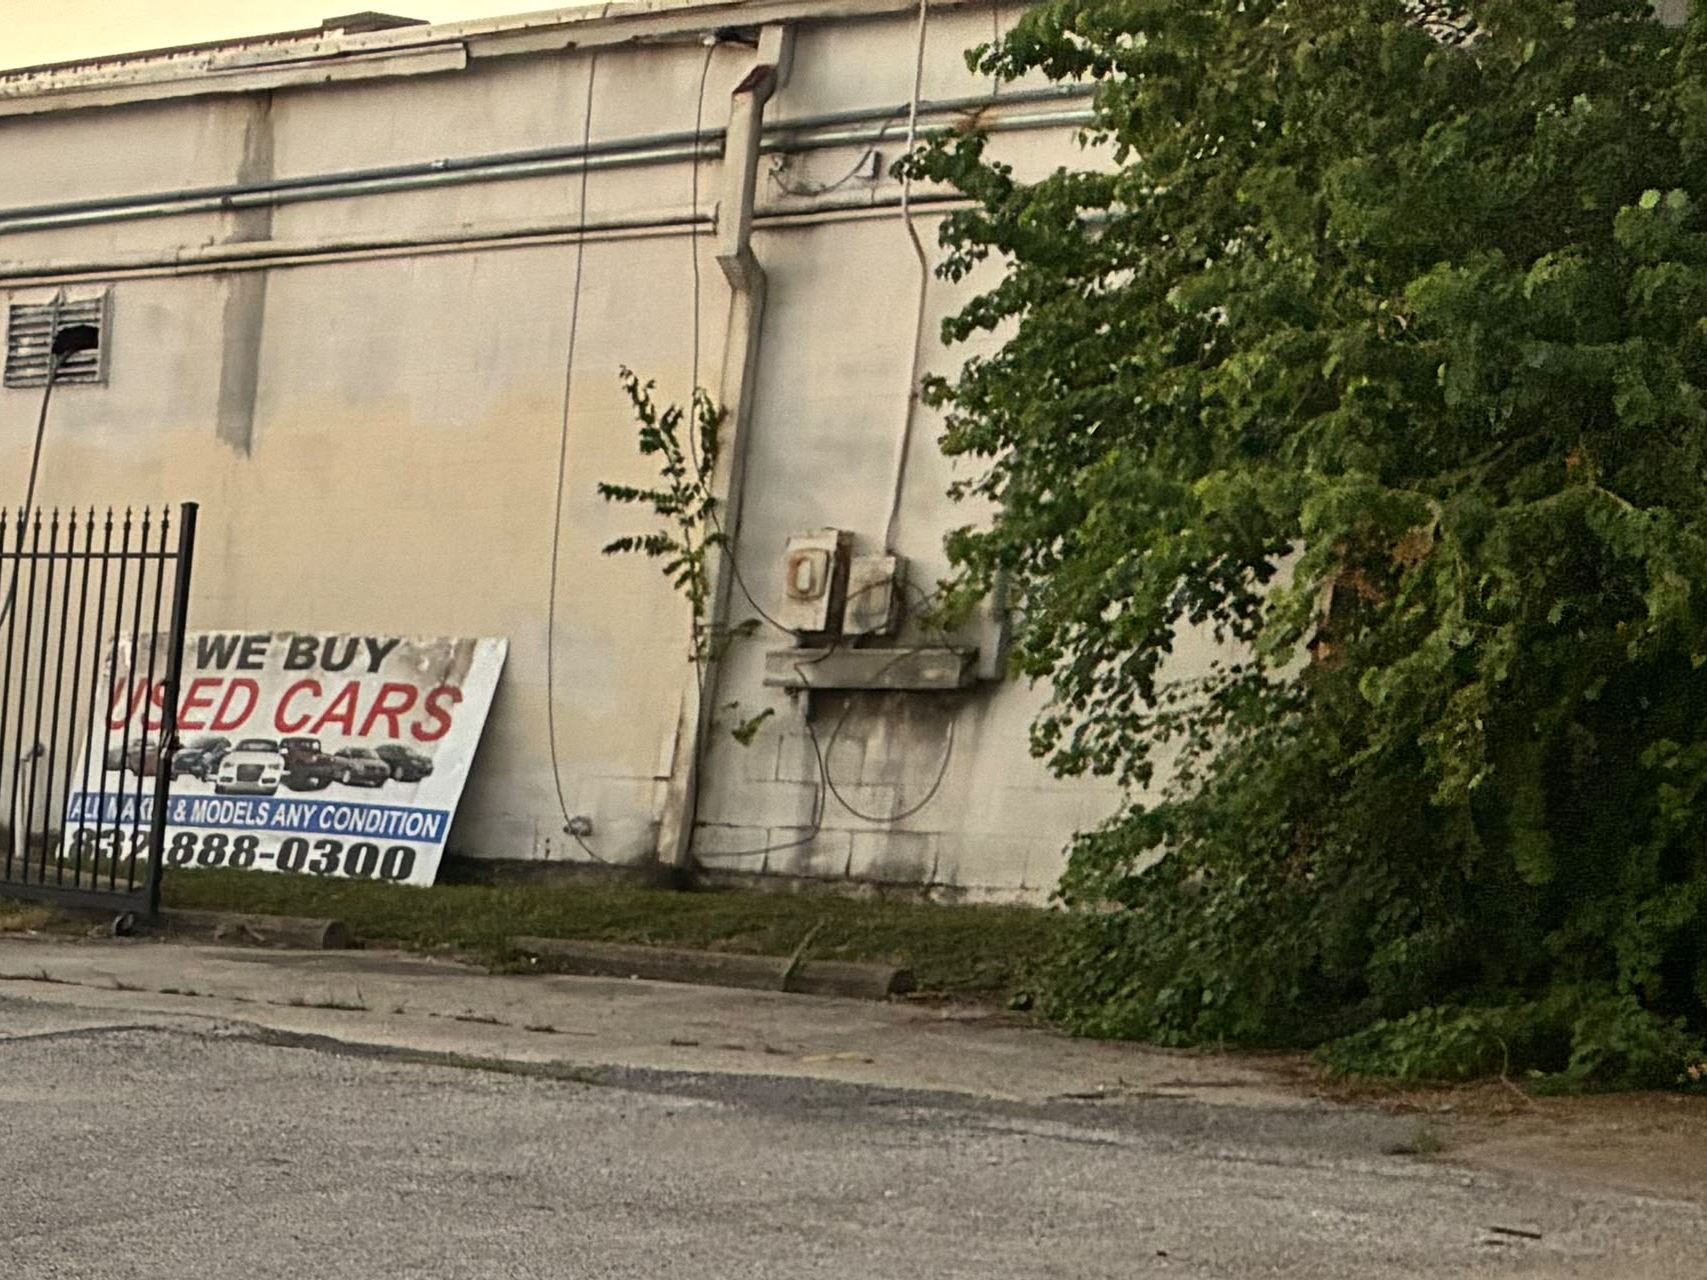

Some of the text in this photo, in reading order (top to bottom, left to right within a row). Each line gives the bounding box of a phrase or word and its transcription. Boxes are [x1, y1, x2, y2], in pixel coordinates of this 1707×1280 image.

[195, 634, 400, 673] WE BUY
[273, 678, 464, 742] CARS
[173, 799, 187, 823] &
[190, 800, 269, 826] MODELS
[271, 803, 318, 828] ANY
[319, 805, 441, 839] CONDITION
